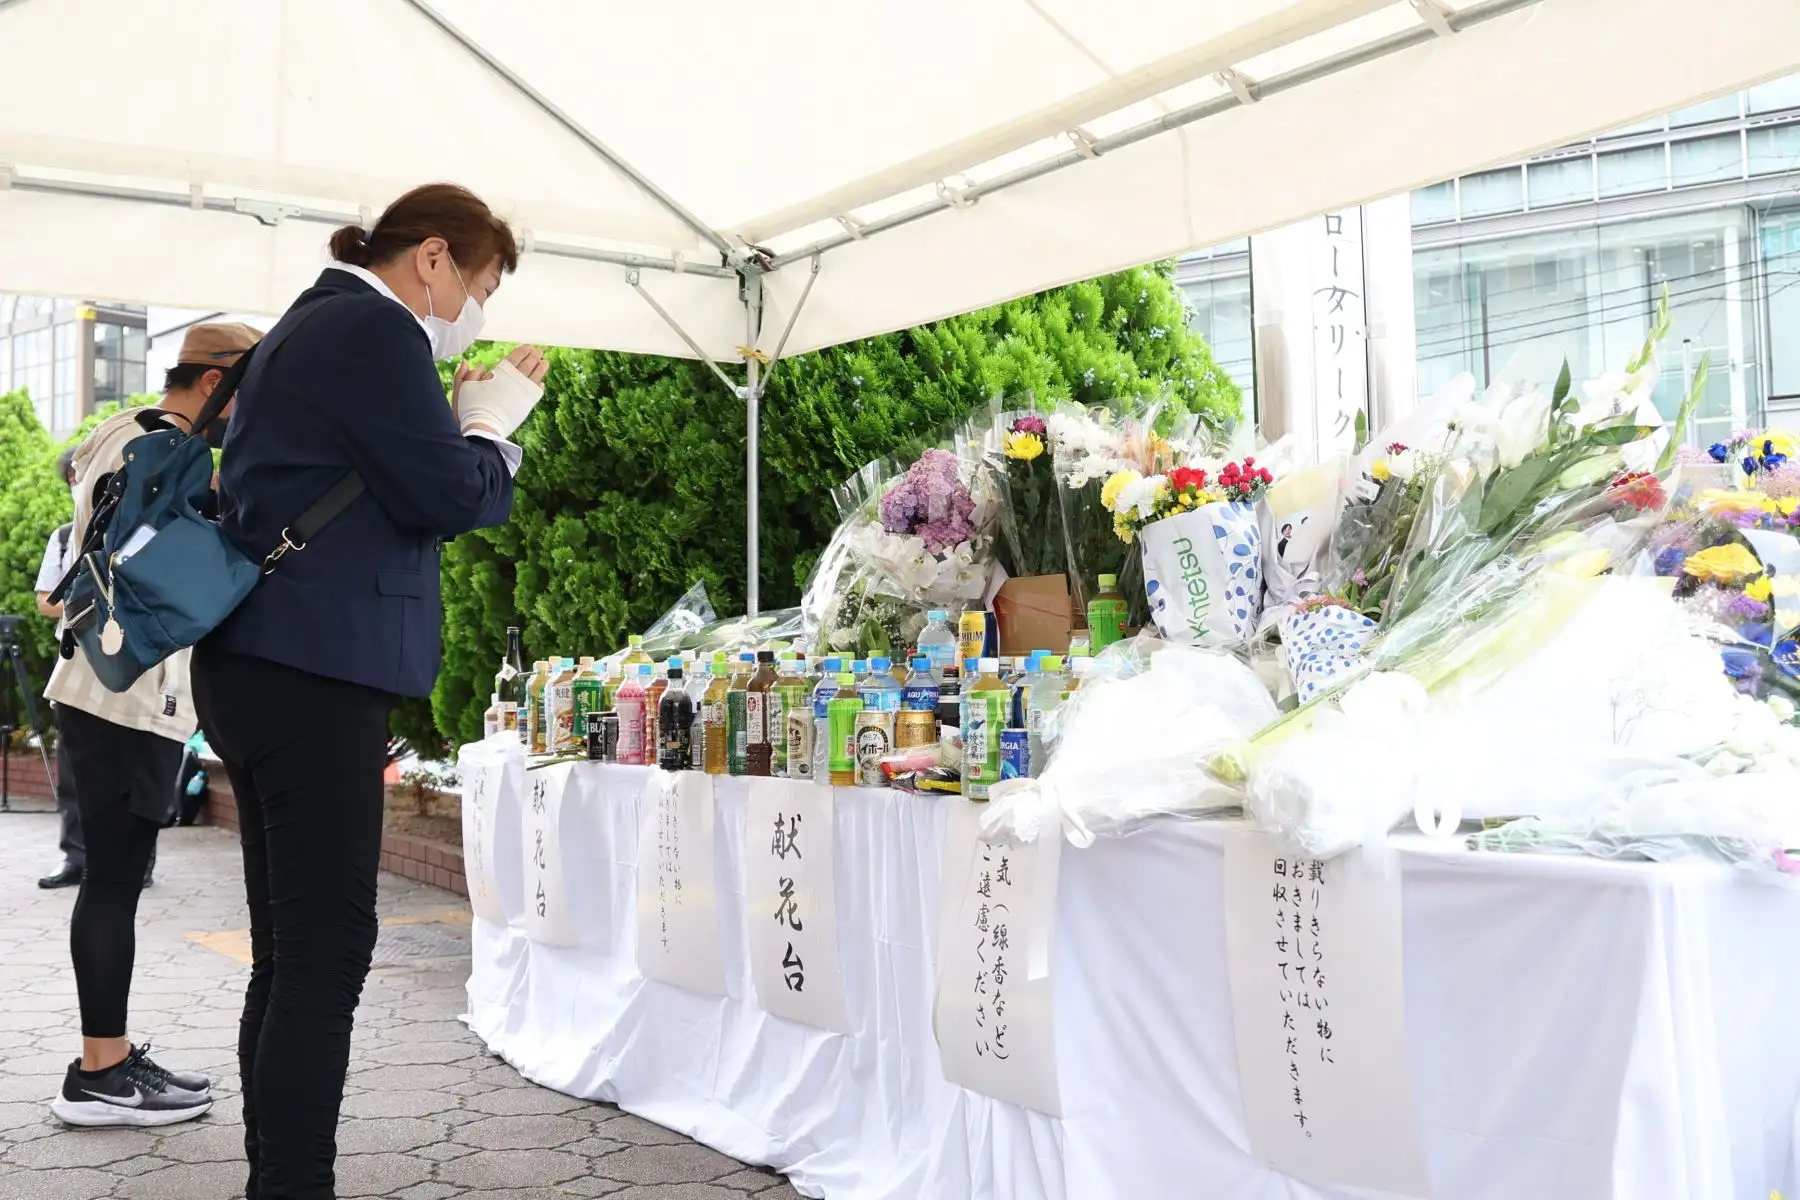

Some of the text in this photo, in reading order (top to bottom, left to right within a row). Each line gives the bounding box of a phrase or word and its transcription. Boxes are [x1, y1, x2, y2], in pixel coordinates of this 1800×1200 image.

[533, 779, 546, 918] 献花台
[771, 812, 804, 992] 献花台
[1291, 860, 1311, 1009] おきましては
[1308, 859, 1335, 1064] 載りきらない物に
